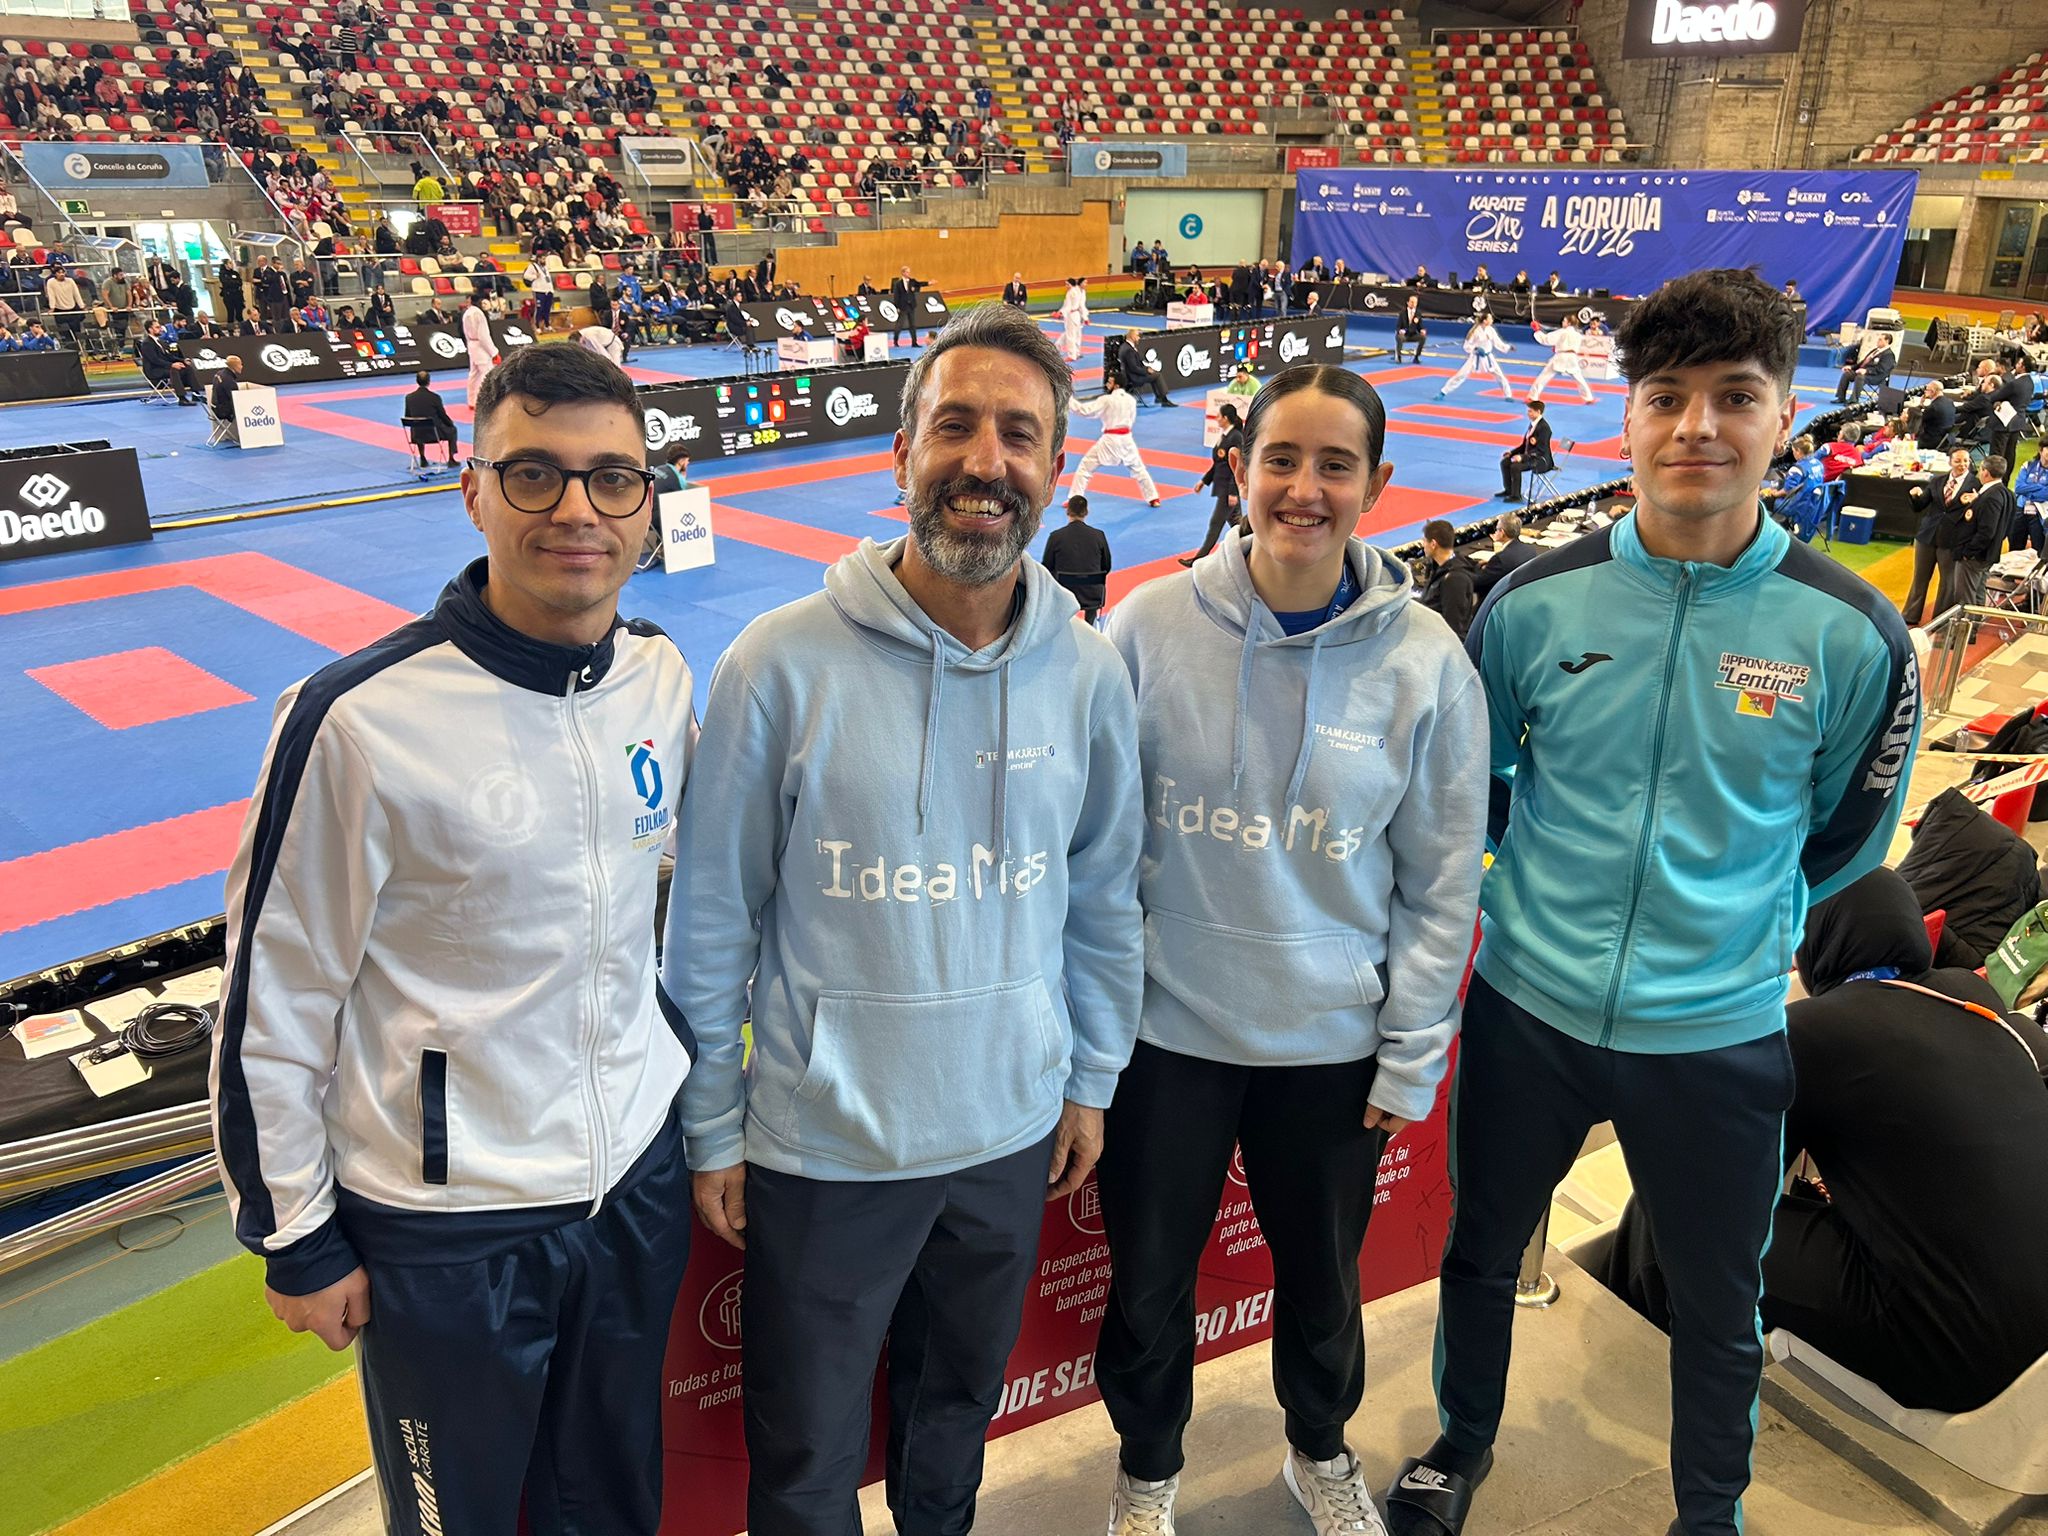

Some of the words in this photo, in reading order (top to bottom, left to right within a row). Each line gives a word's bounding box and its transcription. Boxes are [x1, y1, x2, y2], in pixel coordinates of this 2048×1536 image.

[1651, 0, 1776, 44] Daedo
[94, 162, 124, 171] Concello
[126, 162, 136, 171] da
[137, 162, 163, 171] Coruña
[1455, 175, 1483, 184] THE
[1495, 175, 1550, 185] WORLD
[1563, 176, 1580, 185] IS
[1593, 176, 1626, 185] OUR
[1641, 176, 1688, 186] DOJO
[1468, 196, 1527, 212] KARATE
[1541, 195, 1557, 228] A
[1564, 192, 1661, 231] CORUÑA
[1465, 210, 1524, 241] One
[1466, 241, 1509, 253] SERIES
[1558, 226, 1637, 257] 2026
[193, 357, 228, 370] Daed
[850, 403, 879, 418] SPORT
[851, 393, 874, 407] BEST
[244, 414, 275, 429] Daedo
[669, 425, 702, 442] SPORT
[671, 415, 694, 429] BEST
[0, 500, 106, 545] Daedo
[671, 524, 706, 543] Daedo
[634, 806, 669, 835] FIJLKAM
[1156, 773, 1273, 849] Idea
[822, 840, 957, 902] Idea
[1395, 1144, 1411, 1162] fai
[1375, 1167, 1397, 1187] ade
[1397, 1165, 1411, 1180] co
[1223, 1201, 1232, 1219] é
[1232, 1201, 1248, 1217] un
[1219, 1218, 1249, 1244] parte
[1226, 1233, 1266, 1256] educac
[1041, 1259, 1050, 1277] O
[1052, 1242, 1110, 1273] espectácu
[1040, 1275, 1076, 1298] terreo
[1077, 1267, 1092, 1285] de
[1093, 1262, 1113, 1280] xog
[1055, 1282, 1105, 1313] bancada
[669, 1373, 708, 1398] Todas
[711, 1369, 720, 1383] e
[699, 1384, 744, 1411] mesm
[399, 1418, 420, 1468] SICILIA
[414, 1418, 433, 1480] KARATE
[1410, 1464, 1448, 1487] NIKE
[412, 1471, 444, 1536] KAM
